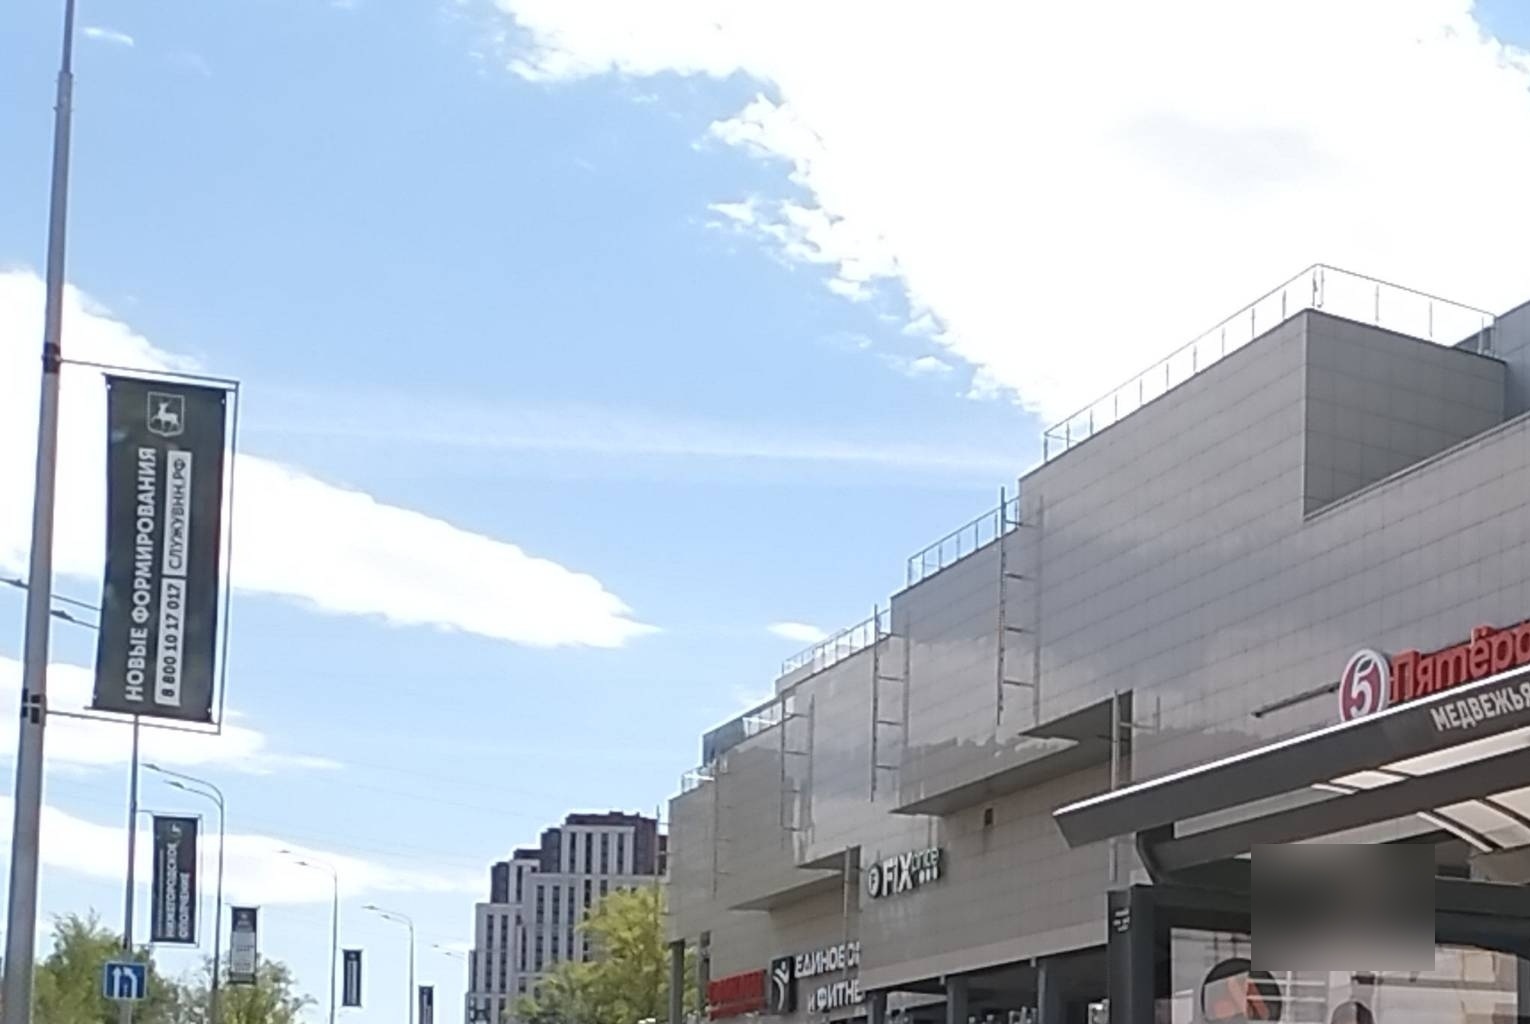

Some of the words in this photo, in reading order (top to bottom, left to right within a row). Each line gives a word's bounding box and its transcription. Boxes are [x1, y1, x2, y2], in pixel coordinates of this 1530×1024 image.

[168, 457, 186, 570] СЛУЖУВНН.РФ
[131, 447, 156, 624] ФОРМИРОВАНИЯ
[167, 583, 181, 611] 017
[166, 613, 179, 631] 17
[165, 634, 178, 652] 10
[125, 627, 148, 702] НОВЫЕ
[163, 656, 177, 686] 800
[163, 687, 175, 698] 8
[881, 852, 913, 897] FIX
[794, 944, 846, 979] ЕДИНОЕ
